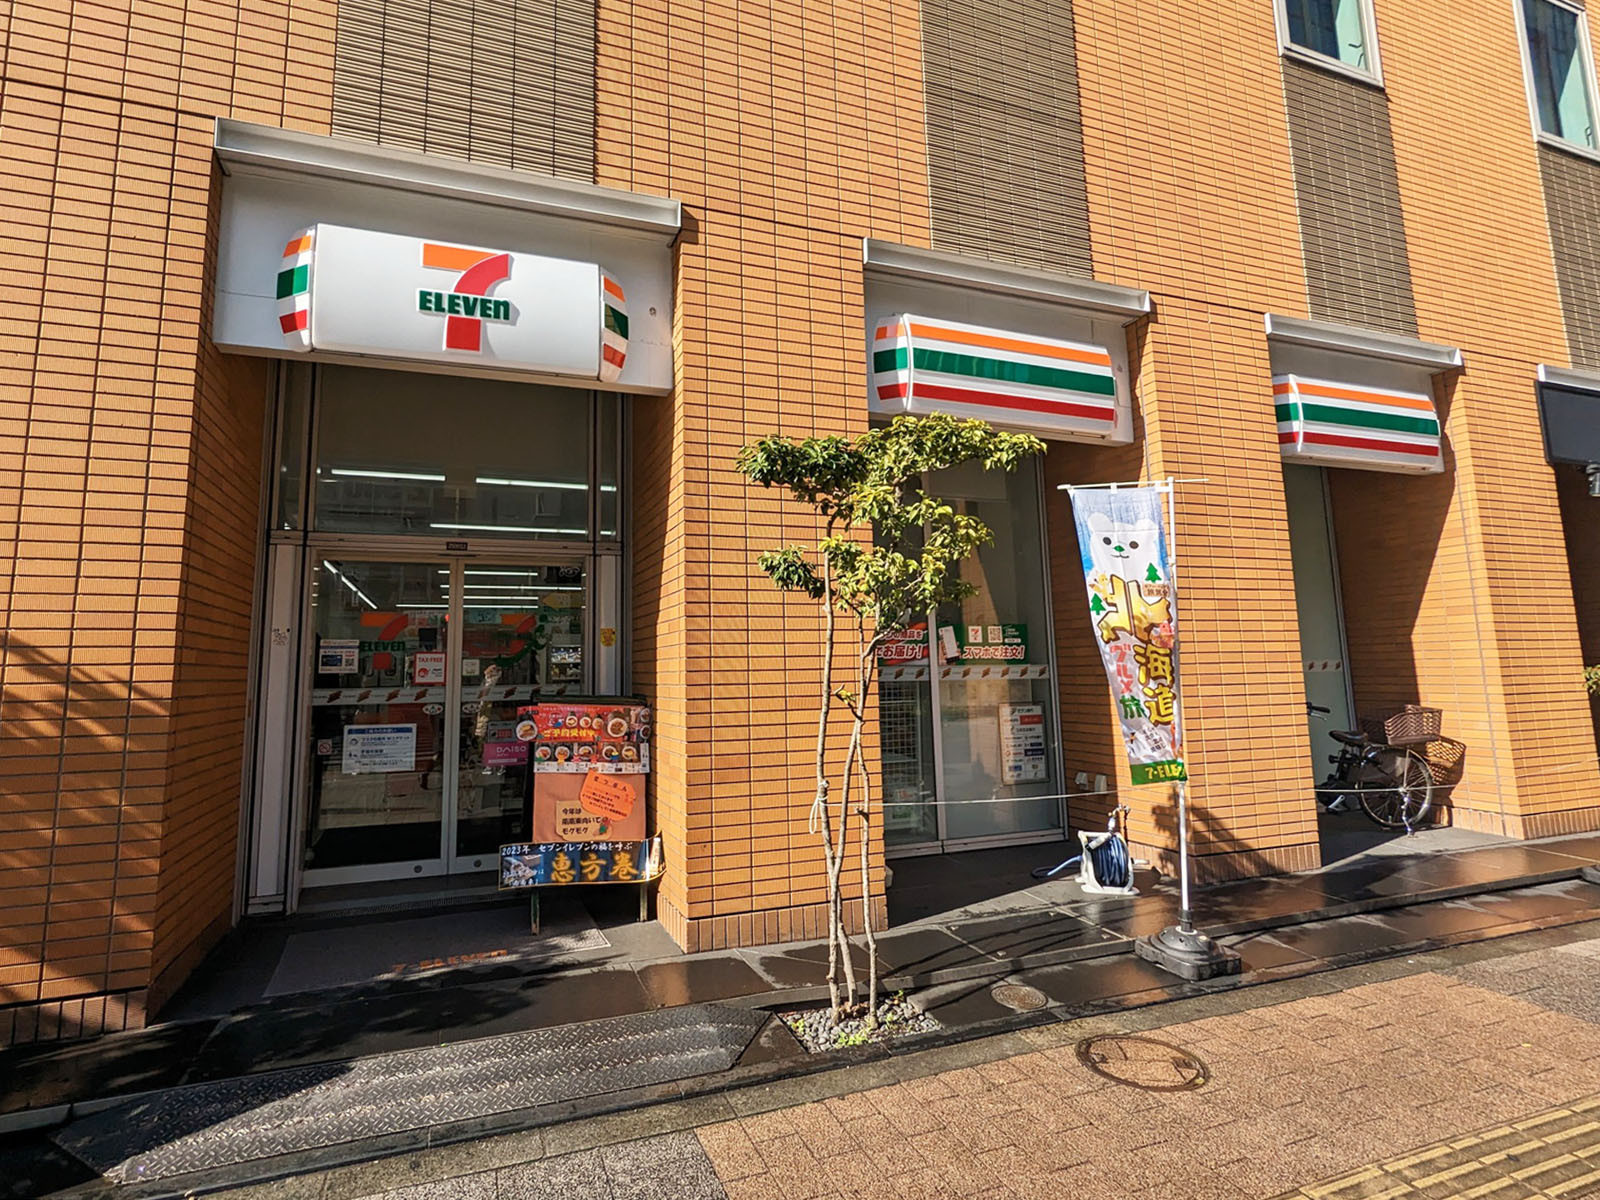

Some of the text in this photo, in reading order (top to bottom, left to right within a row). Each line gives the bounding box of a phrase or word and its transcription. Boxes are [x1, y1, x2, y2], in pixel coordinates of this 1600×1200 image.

[422, 243, 510, 352] 7
[360, 612, 409, 670] 7
[1097, 574, 1176, 727] 北海道
[1110, 643, 1147, 719] グルメ旅
[502, 845, 530, 856] 2023年
[551, 851, 638, 883] 恵方巻
